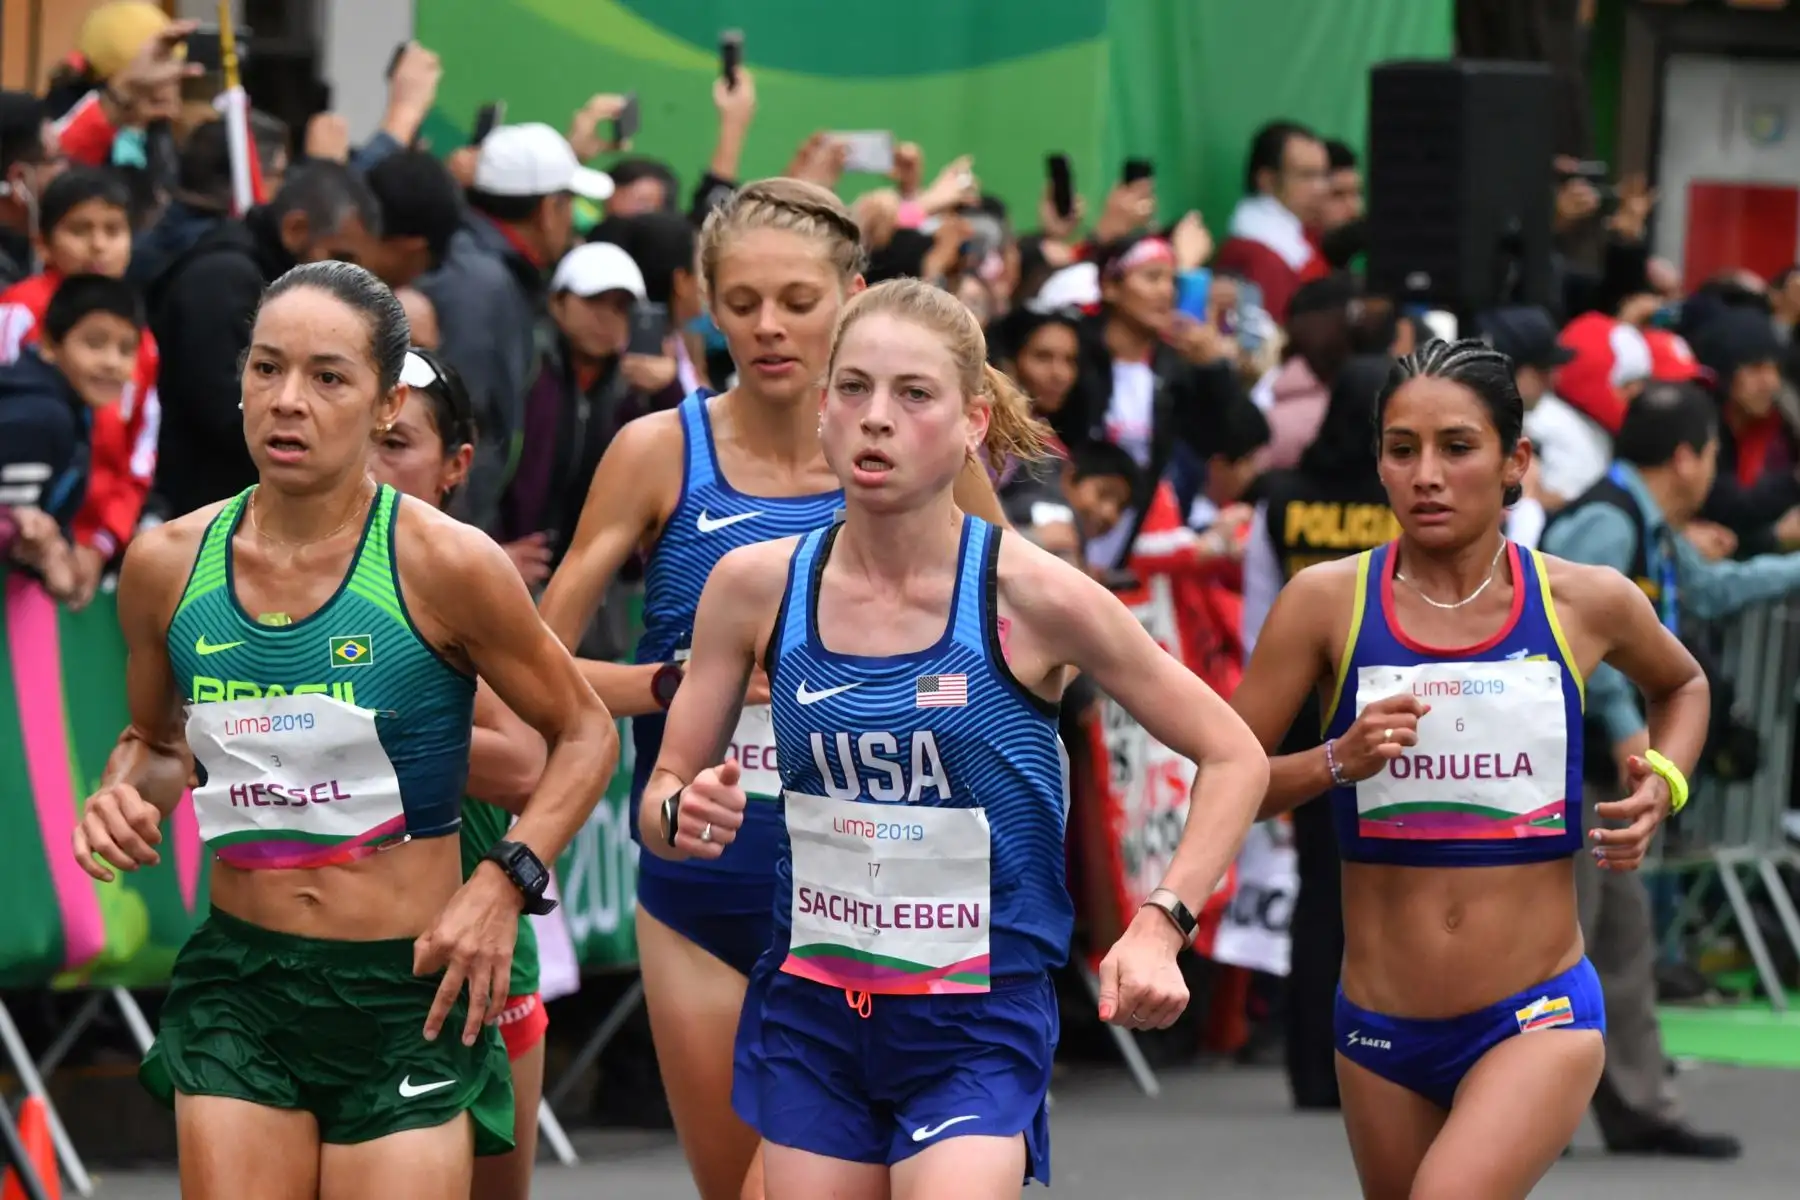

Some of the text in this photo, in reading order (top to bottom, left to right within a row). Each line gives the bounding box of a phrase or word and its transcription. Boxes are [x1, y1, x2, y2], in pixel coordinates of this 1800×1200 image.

[1455, 717, 1465, 732] 6
[270, 754, 282, 768] 3
[808, 729, 952, 802] USA
[1389, 752, 1533, 780] ORJUELA
[229, 779, 352, 808] HESSEL
[867, 861, 881, 878] 17
[798, 886, 981, 931] SACHTLEBEN
